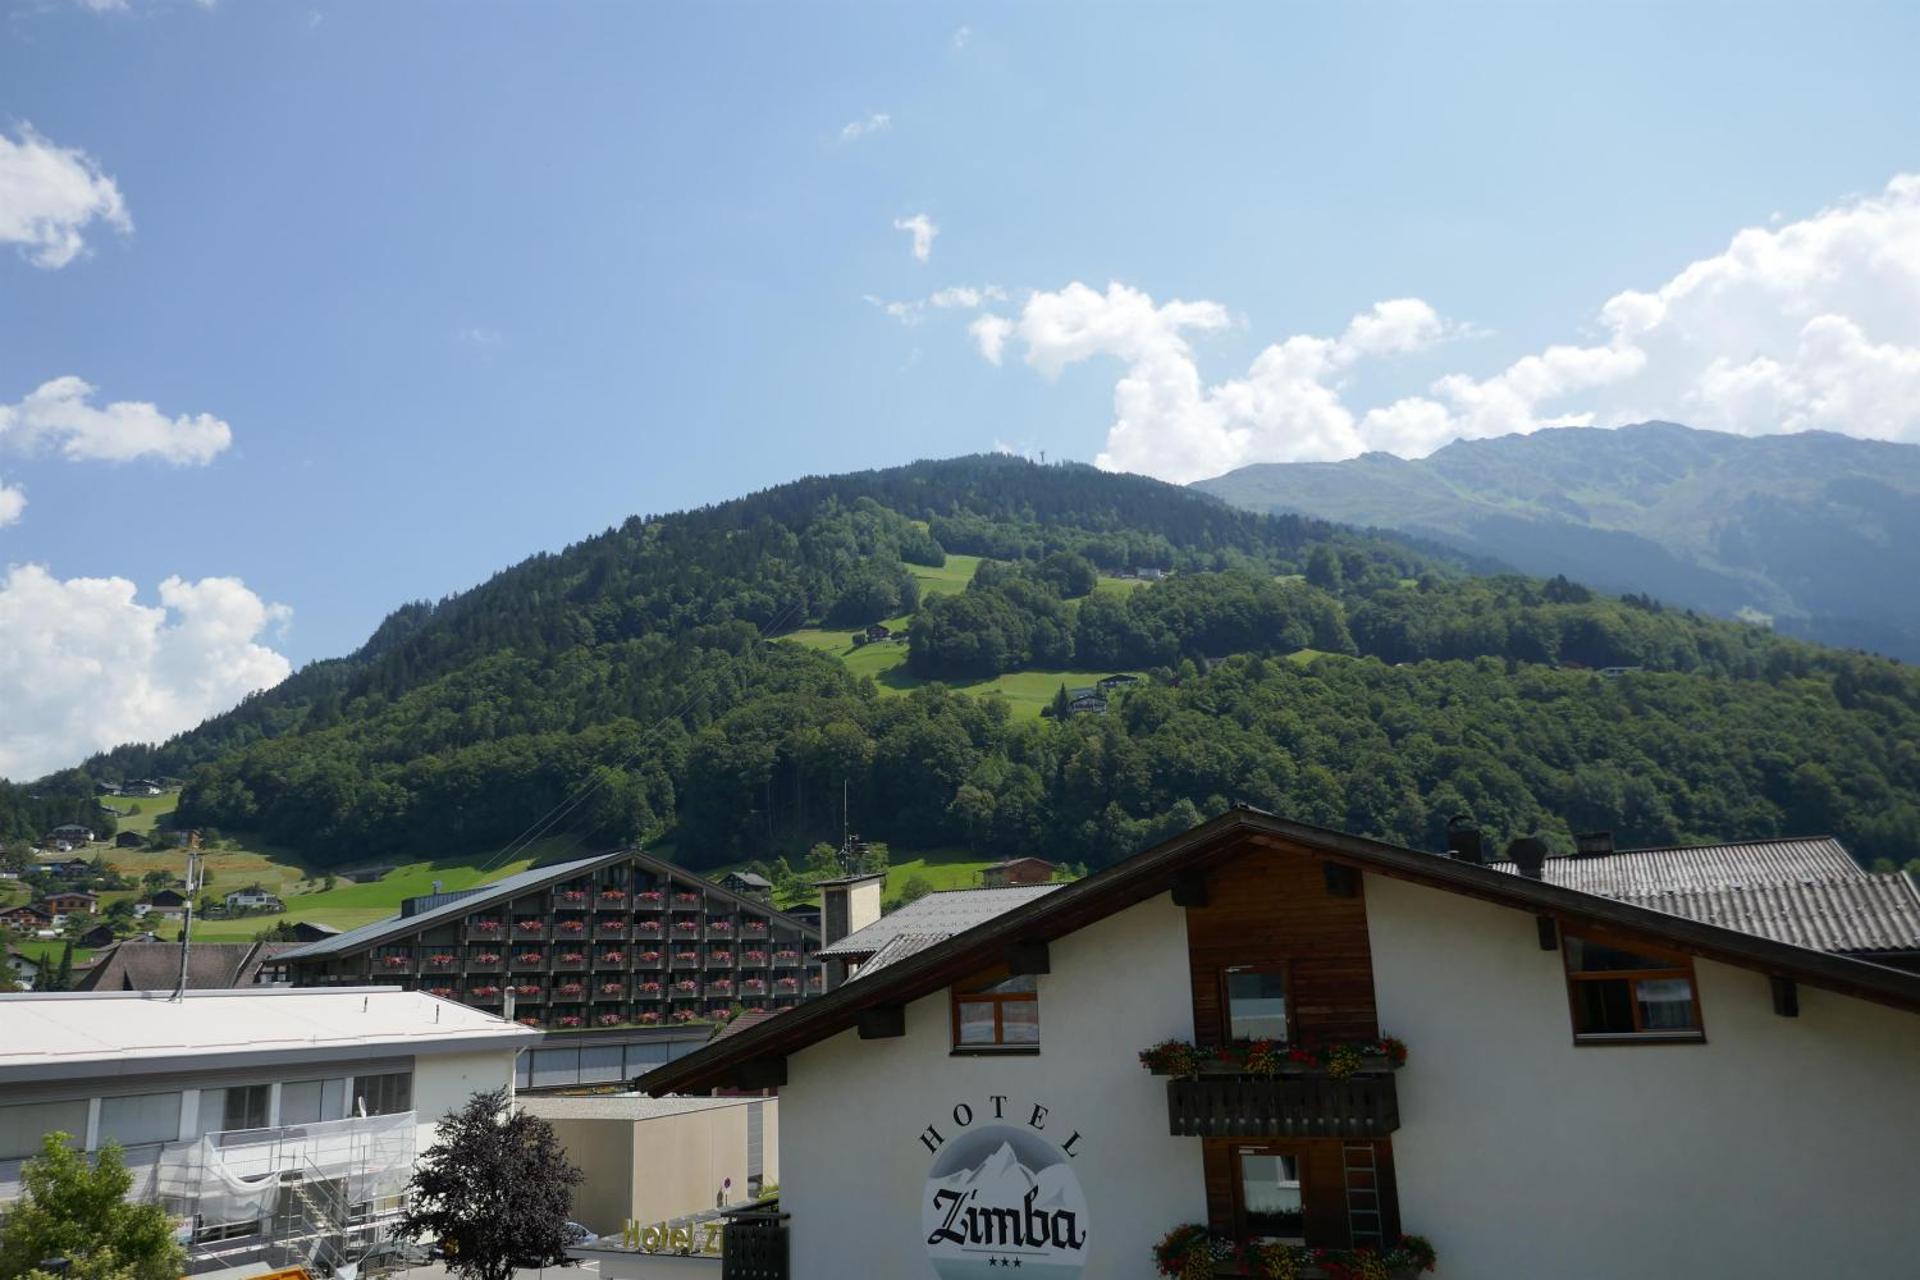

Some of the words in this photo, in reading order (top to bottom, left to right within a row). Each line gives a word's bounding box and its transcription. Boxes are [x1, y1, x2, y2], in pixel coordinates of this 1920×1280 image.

[919, 1095, 1081, 1158] HOTEL
[623, 1217, 694, 1252] Hotel
[927, 1184, 1086, 1250] Zimba
